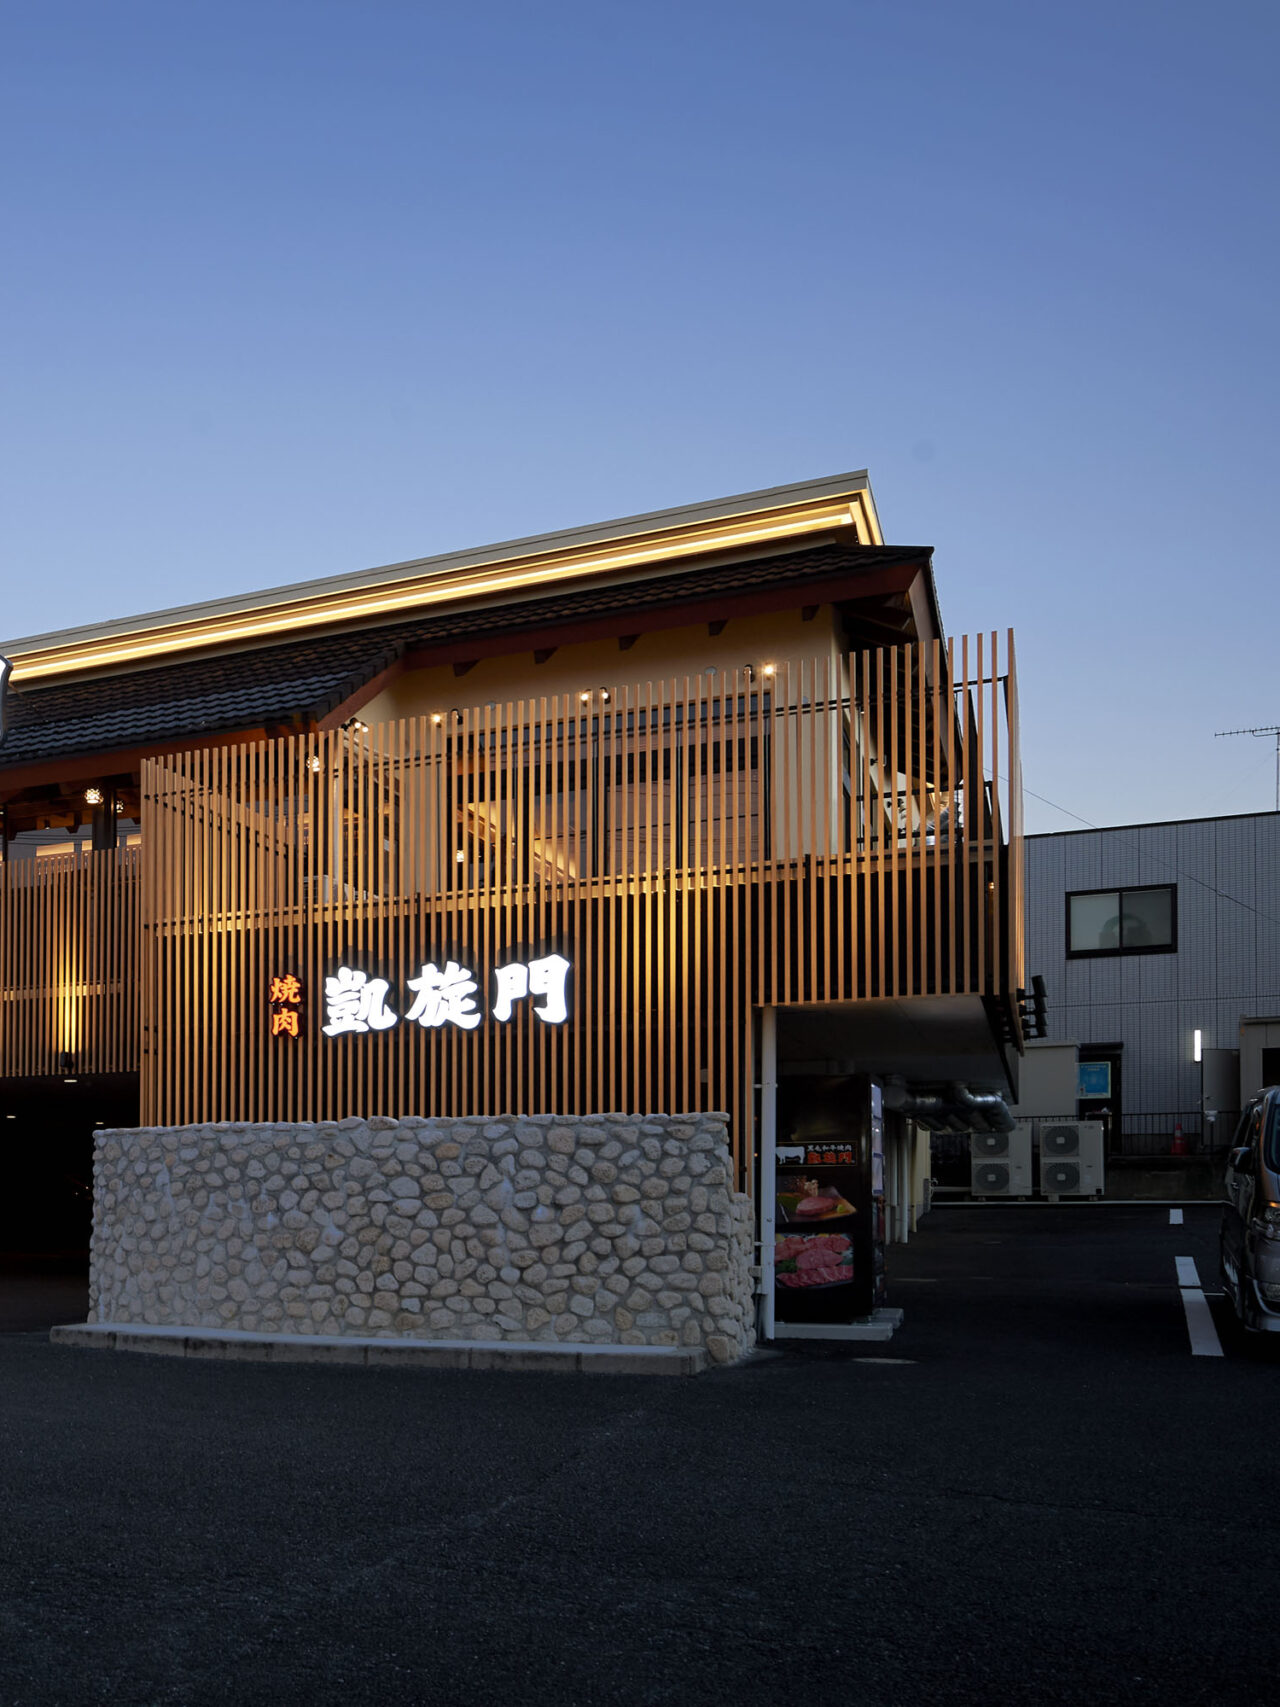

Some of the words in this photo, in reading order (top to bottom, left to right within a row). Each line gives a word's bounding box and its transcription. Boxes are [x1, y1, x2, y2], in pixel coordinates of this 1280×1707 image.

[269, 974, 302, 1038] 焼肉
[321, 953, 571, 1037] 凱旋門
